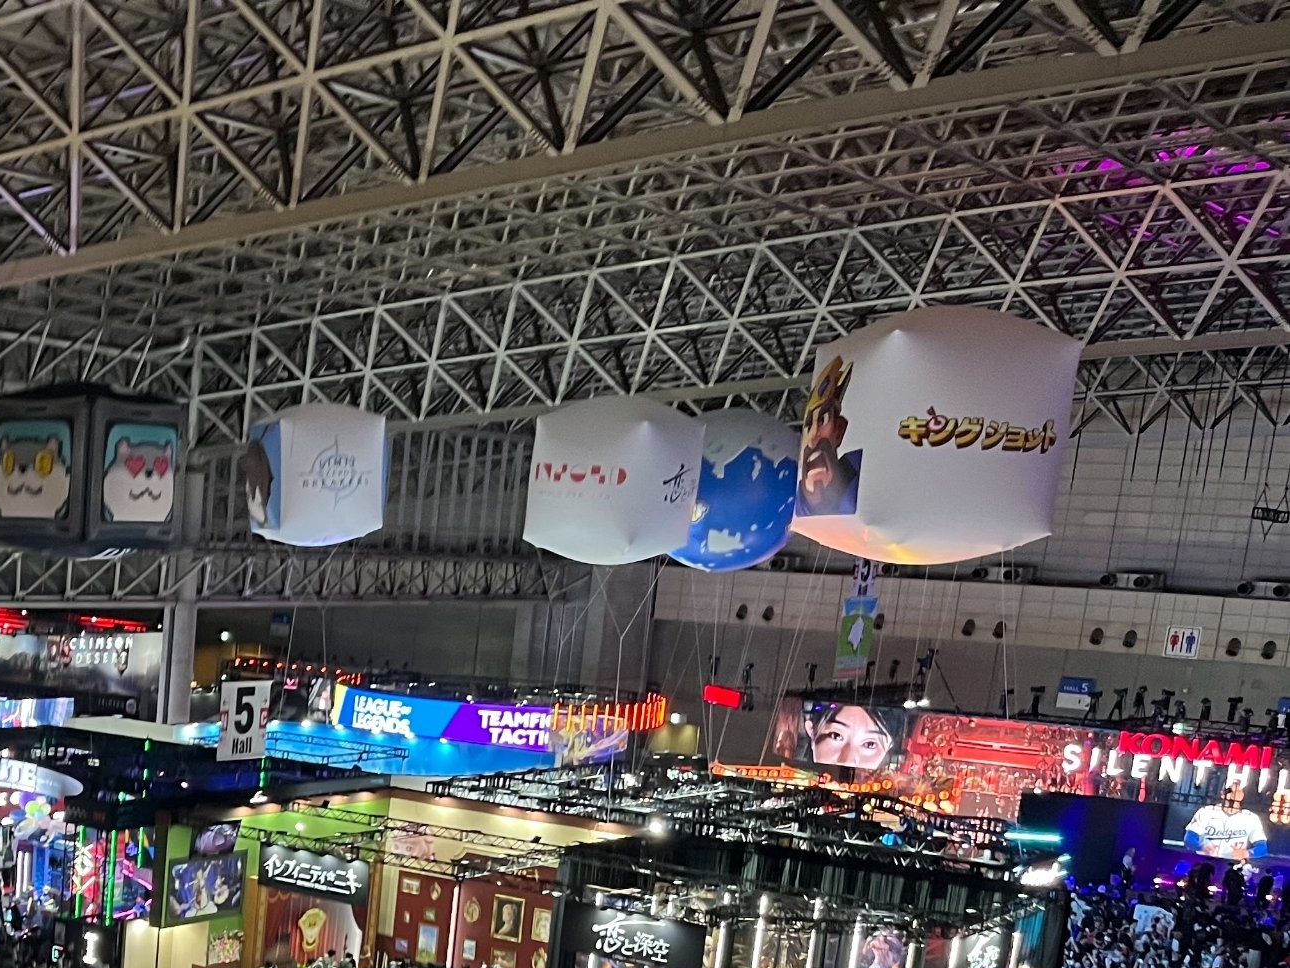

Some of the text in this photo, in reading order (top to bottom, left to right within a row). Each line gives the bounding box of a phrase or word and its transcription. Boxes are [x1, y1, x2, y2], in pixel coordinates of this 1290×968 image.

[898, 415, 1057, 454] キングショット
[70, 635, 134, 650] CRIMSON
[1080, 682, 1089, 693] 5
[234, 686, 255, 734] 5
[353, 694, 402, 718] LEAGUE
[352, 711, 412, 736] LEGENDS
[232, 737, 252, 755] Hall
[1118, 730, 1274, 769] KONAMI
[1062, 744, 1213, 786] SILENT
[1204, 825, 1247, 842] Dodgers
[592, 912, 670, 963] 恋と深空
